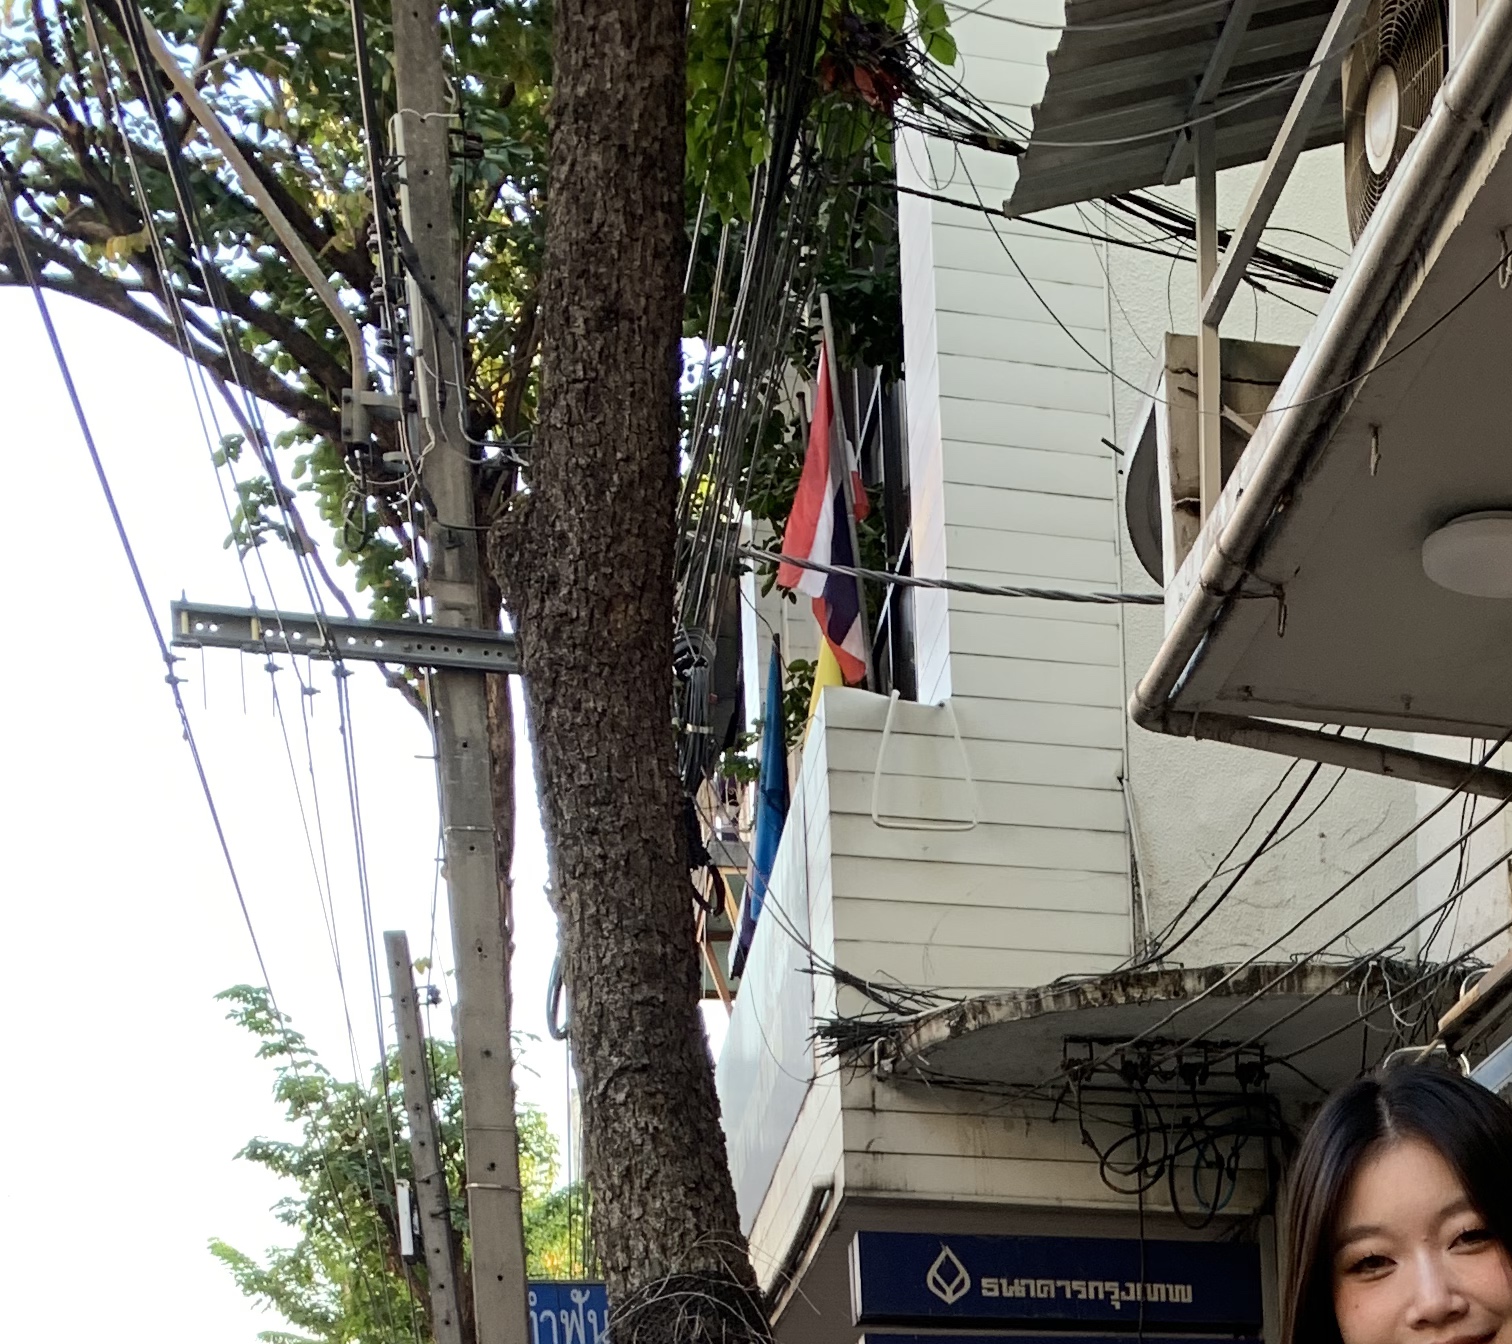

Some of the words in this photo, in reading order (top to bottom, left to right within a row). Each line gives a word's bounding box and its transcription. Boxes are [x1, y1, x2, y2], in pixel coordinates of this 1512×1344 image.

[980, 1277, 1193, 1310] ธนาคารกรุงเทพ
